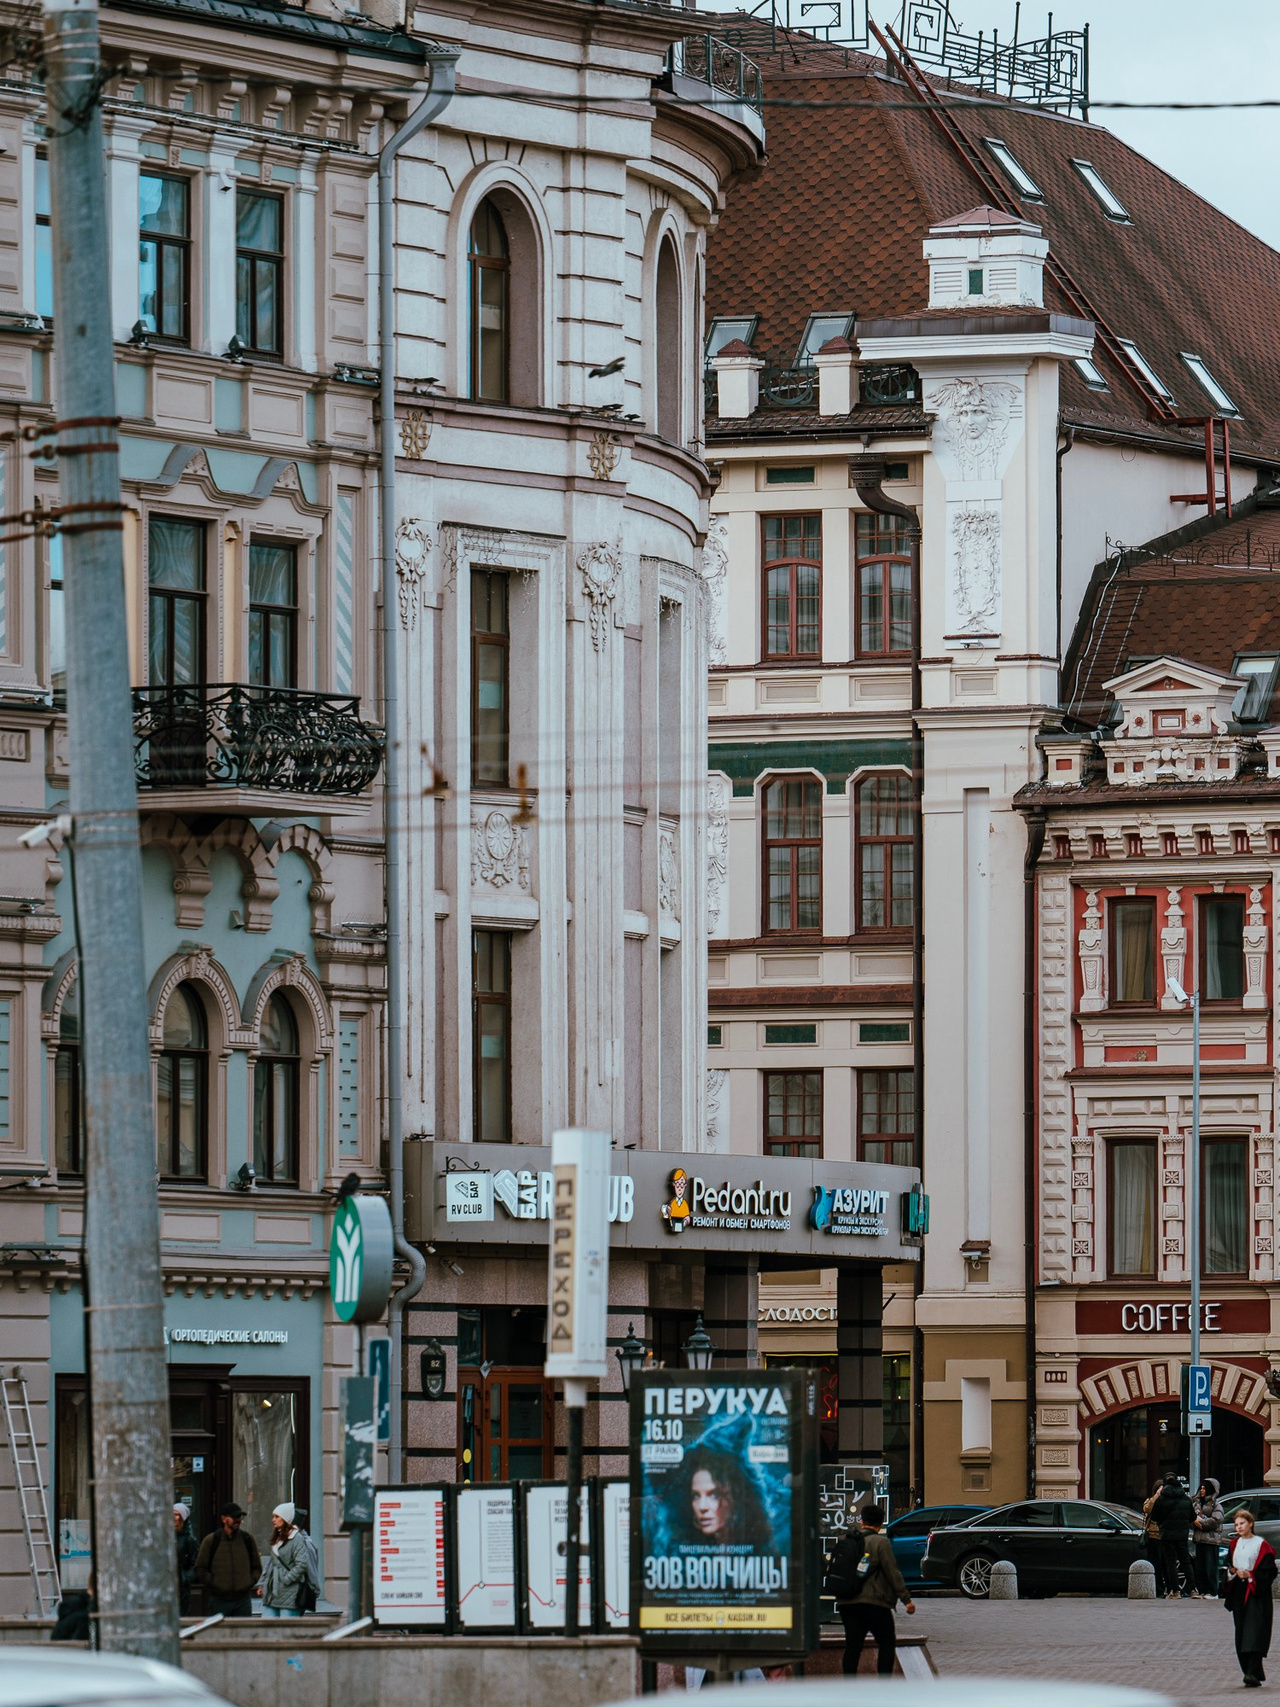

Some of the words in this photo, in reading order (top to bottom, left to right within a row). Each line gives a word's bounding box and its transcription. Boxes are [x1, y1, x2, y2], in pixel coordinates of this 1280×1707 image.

[470, 1181, 479, 1198] БАР
[517, 1170, 538, 1219] БАР
[693, 1177, 791, 1216] Pedant.ru
[833, 1189, 890, 1215] АЗУРИТ
[451, 1204, 462, 1215] RV
[463, 1203, 483, 1215] CLUB
[693, 1216, 718, 1227] РЕМОНТ
[719, 1218, 725, 1227] И
[725, 1218, 748, 1229] ОБМЕН
[750, 1219, 791, 1230] СМАРТФОНОВ
[552, 1179, 573, 1340] ПЕРЕХОД
[1121, 1303, 1221, 1331] COFFEE
[174, 1329, 250, 1345] ОРТОПЕДИЧЕСКИЕ
[252, 1330, 288, 1343] САЛОНЫ
[644, 1387, 788, 1415] ПЕРУКУА
[644, 1419, 683, 1441] 16.10
[644, 1556, 684, 1590] ЗОВ
[686, 1555, 788, 1593] ВОЛЧИЦЫ
[665, 1612, 679, 1622] ВСЕ
[681, 1612, 713, 1622] БИЛЕТЫ
